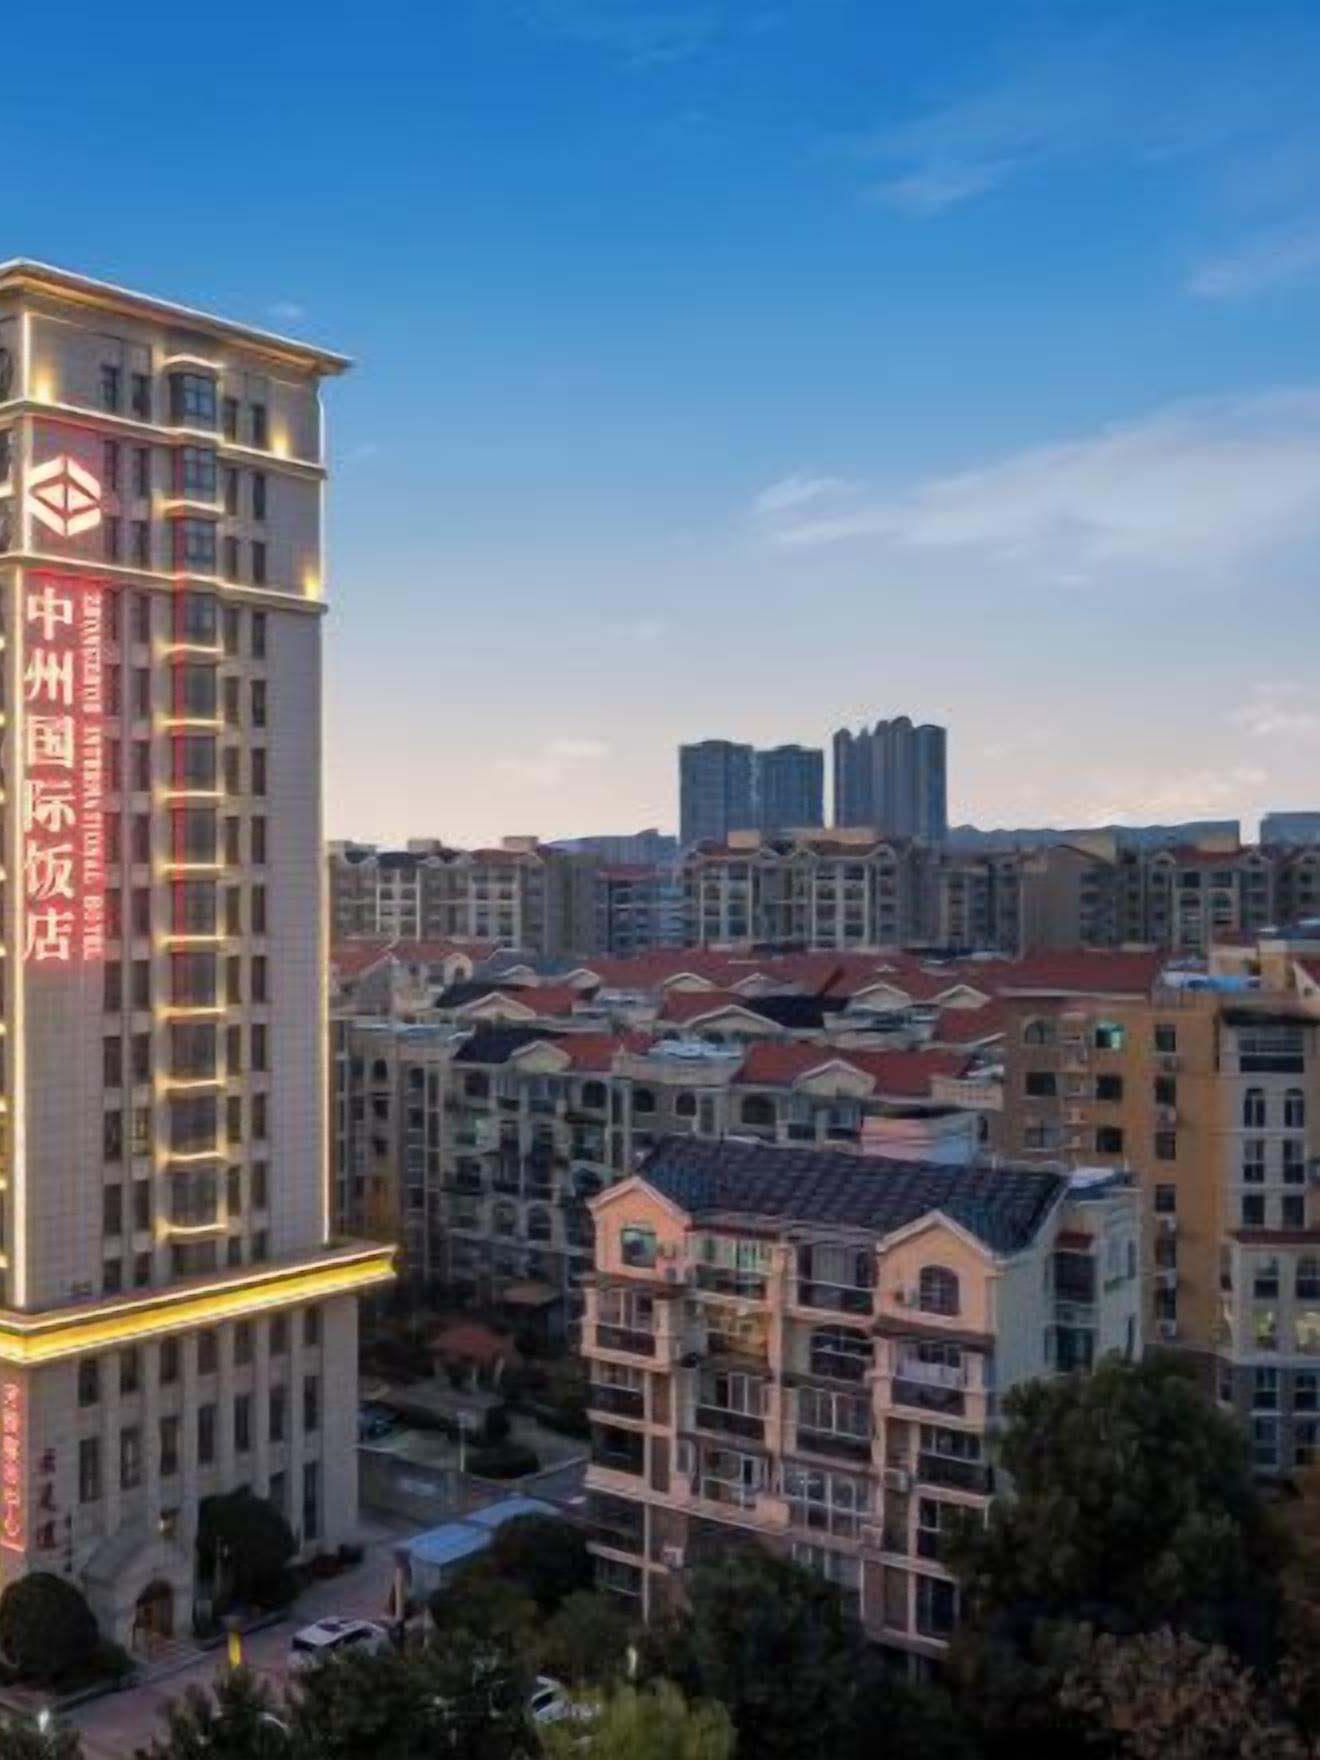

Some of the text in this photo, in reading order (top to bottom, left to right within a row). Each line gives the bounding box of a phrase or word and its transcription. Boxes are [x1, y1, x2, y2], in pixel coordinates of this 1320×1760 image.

[23, 587, 76, 961] 中州国际饭店
